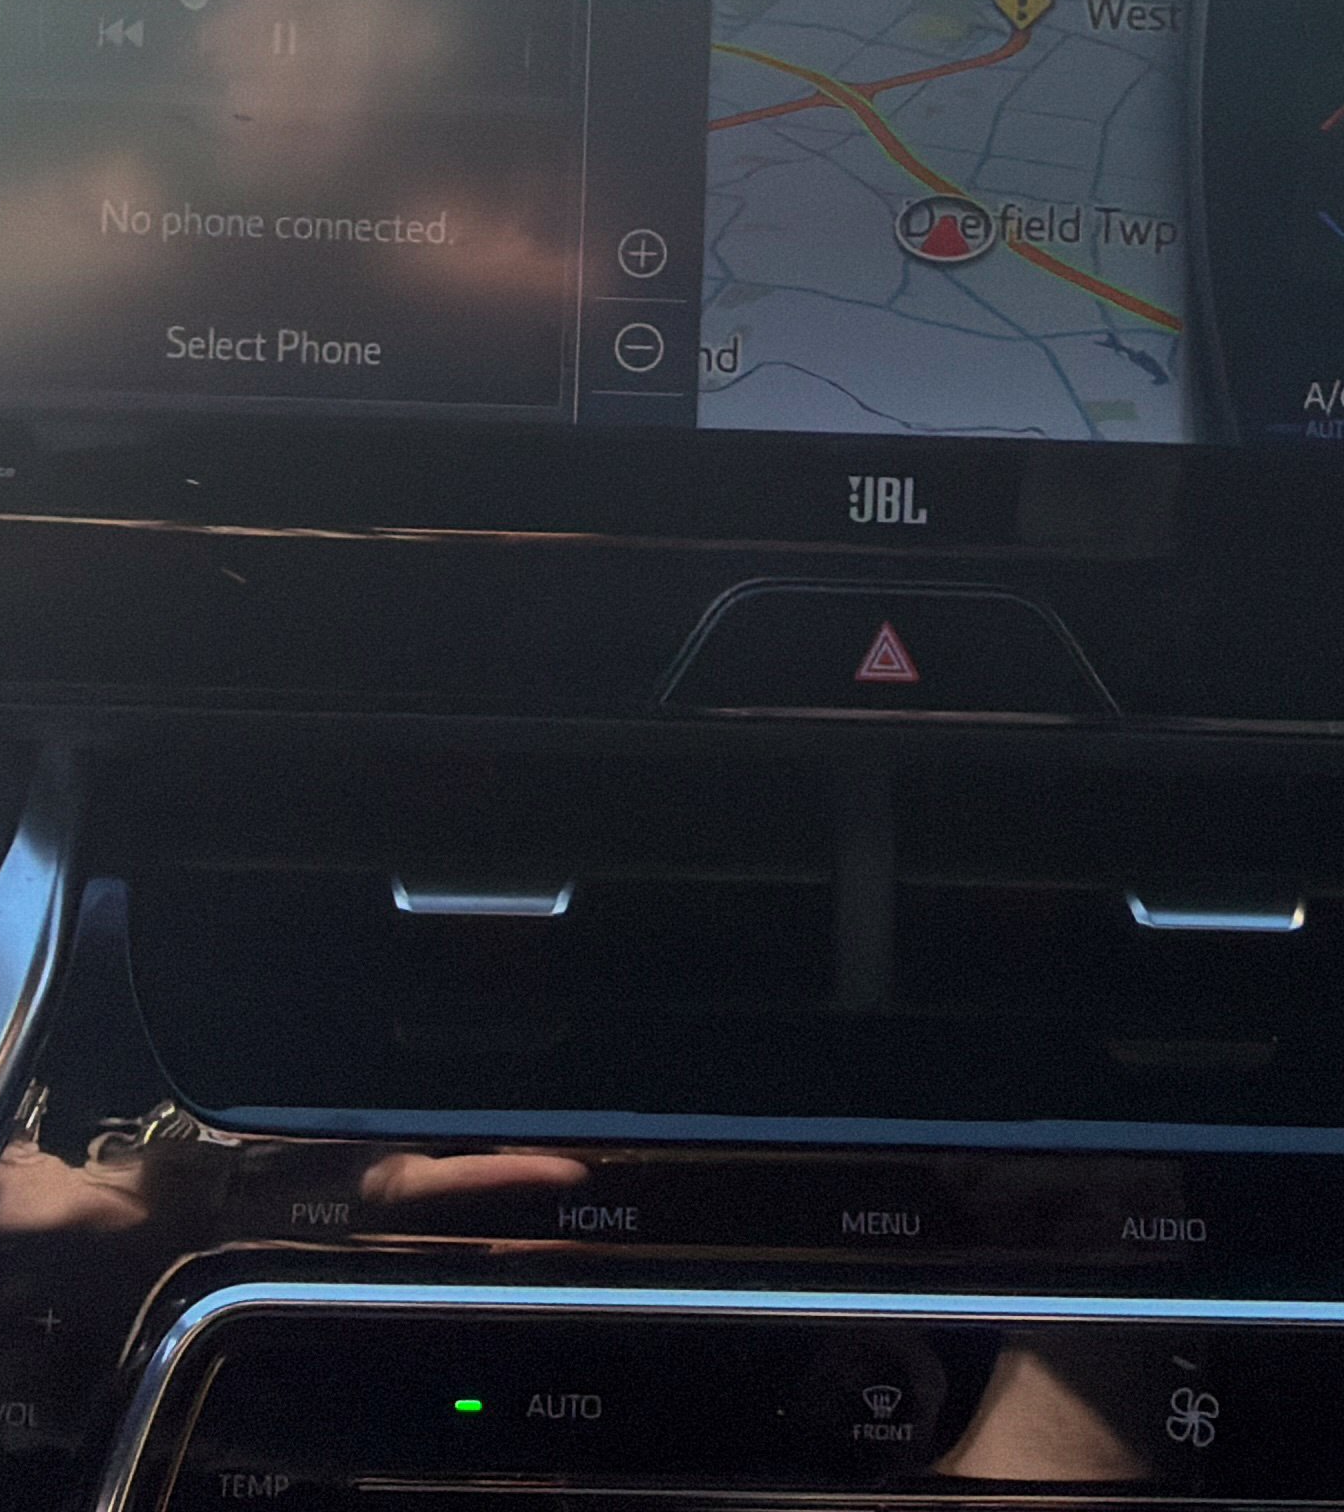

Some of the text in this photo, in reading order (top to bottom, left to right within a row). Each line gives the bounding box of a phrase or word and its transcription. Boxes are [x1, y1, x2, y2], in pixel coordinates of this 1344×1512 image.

[99, 199, 455, 246] No phone connected.
[1093, 206, 1178, 255] Twp
[165, 326, 382, 366] Select Phone
[848, 475, 928, 525] JBL
[289, 1200, 351, 1227] PWR
[557, 1204, 640, 1233] HOME
[841, 1209, 922, 1237] MENU
[1120, 1214, 1207, 1244] AUDIO
[526, 1393, 604, 1422] AUTO
[853, 1422, 915, 1443] FRONT
[218, 1473, 292, 1501] TEMP
